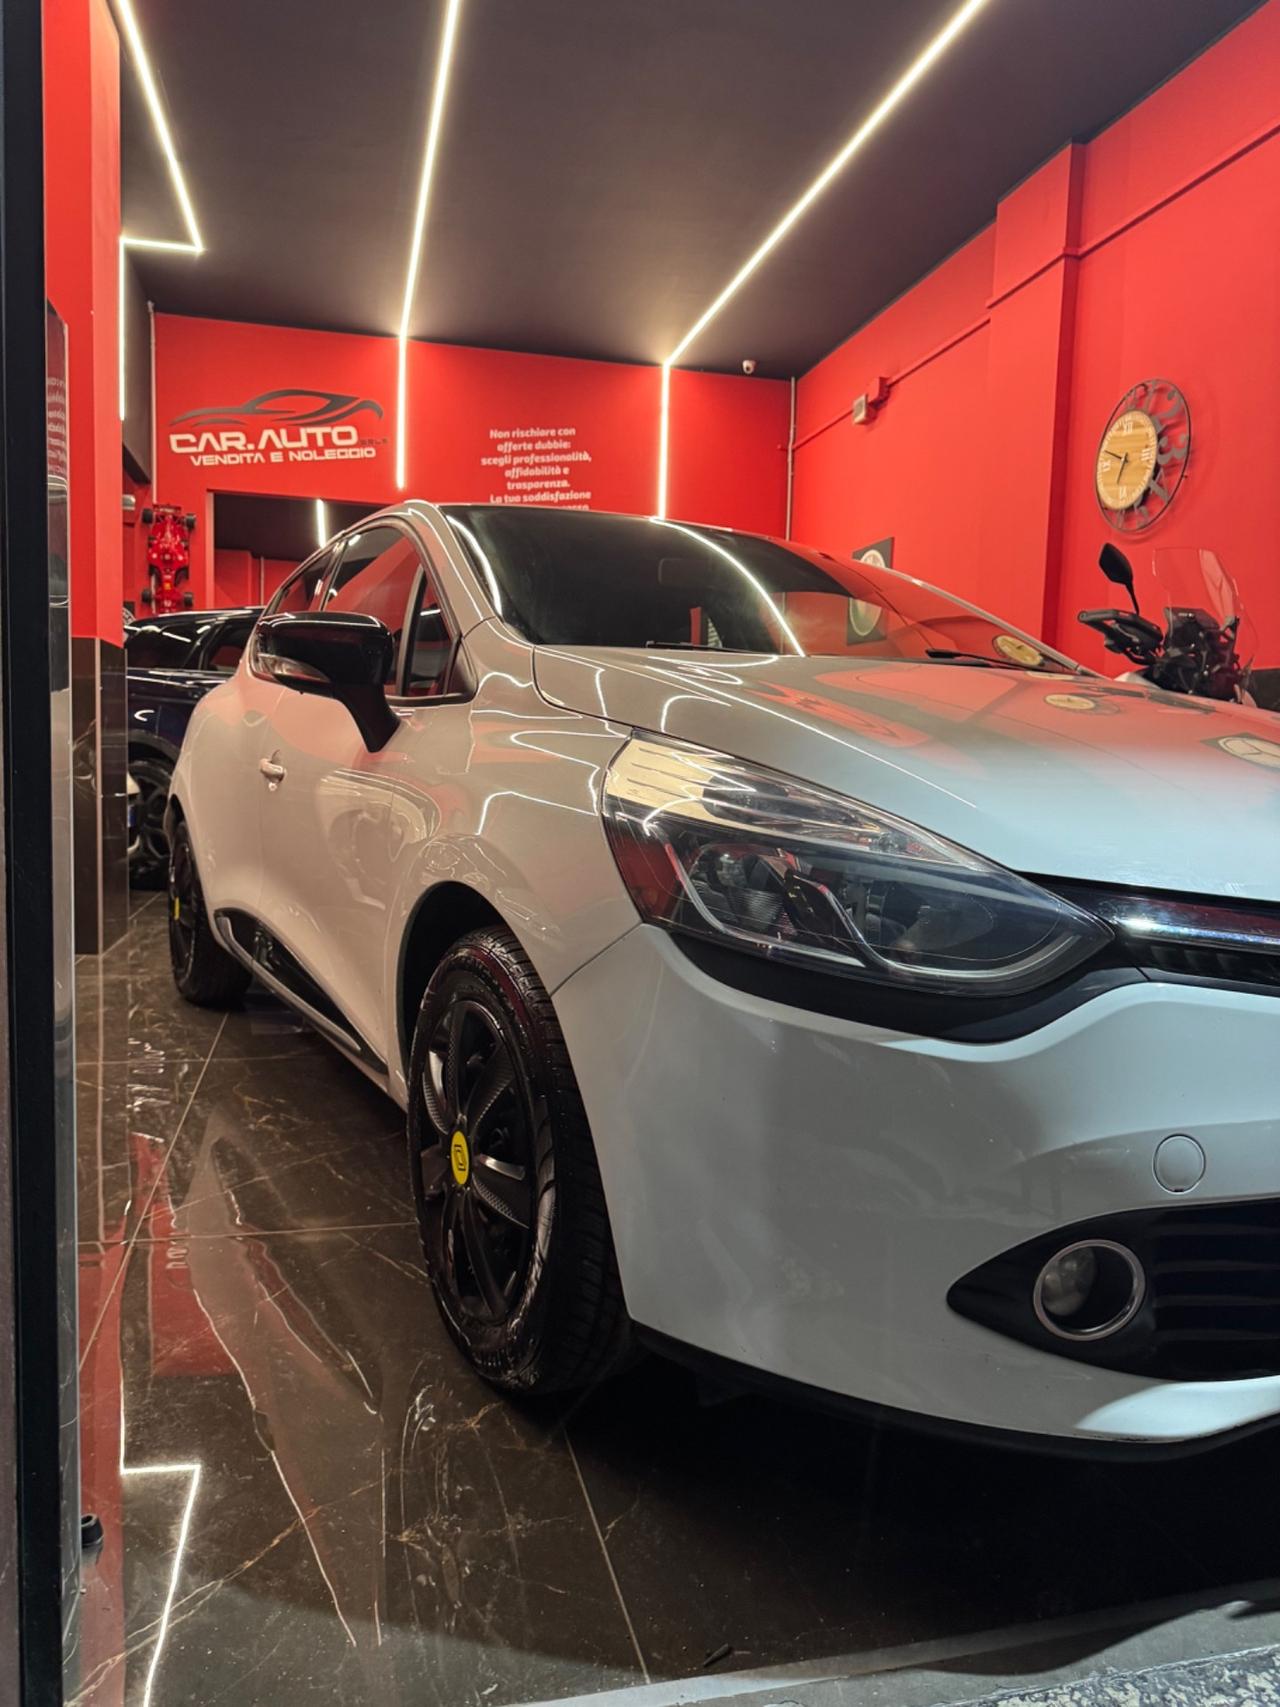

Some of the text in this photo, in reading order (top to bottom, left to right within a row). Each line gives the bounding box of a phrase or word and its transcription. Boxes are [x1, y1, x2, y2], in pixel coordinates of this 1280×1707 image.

[169, 425, 359, 453] CAR.AUTO
[489, 427, 576, 439] Non rischiare con
[497, 439, 571, 453] offerte dubbie:
[190, 447, 376, 466] VENDITA E NOLEGGIO
[481, 451, 592, 467] scegli professionalità,
[504, 465, 570, 479] affidabilità e
[506, 479, 571, 491] trasparenza.
[490, 490, 592, 504] La tua soddisfazione
